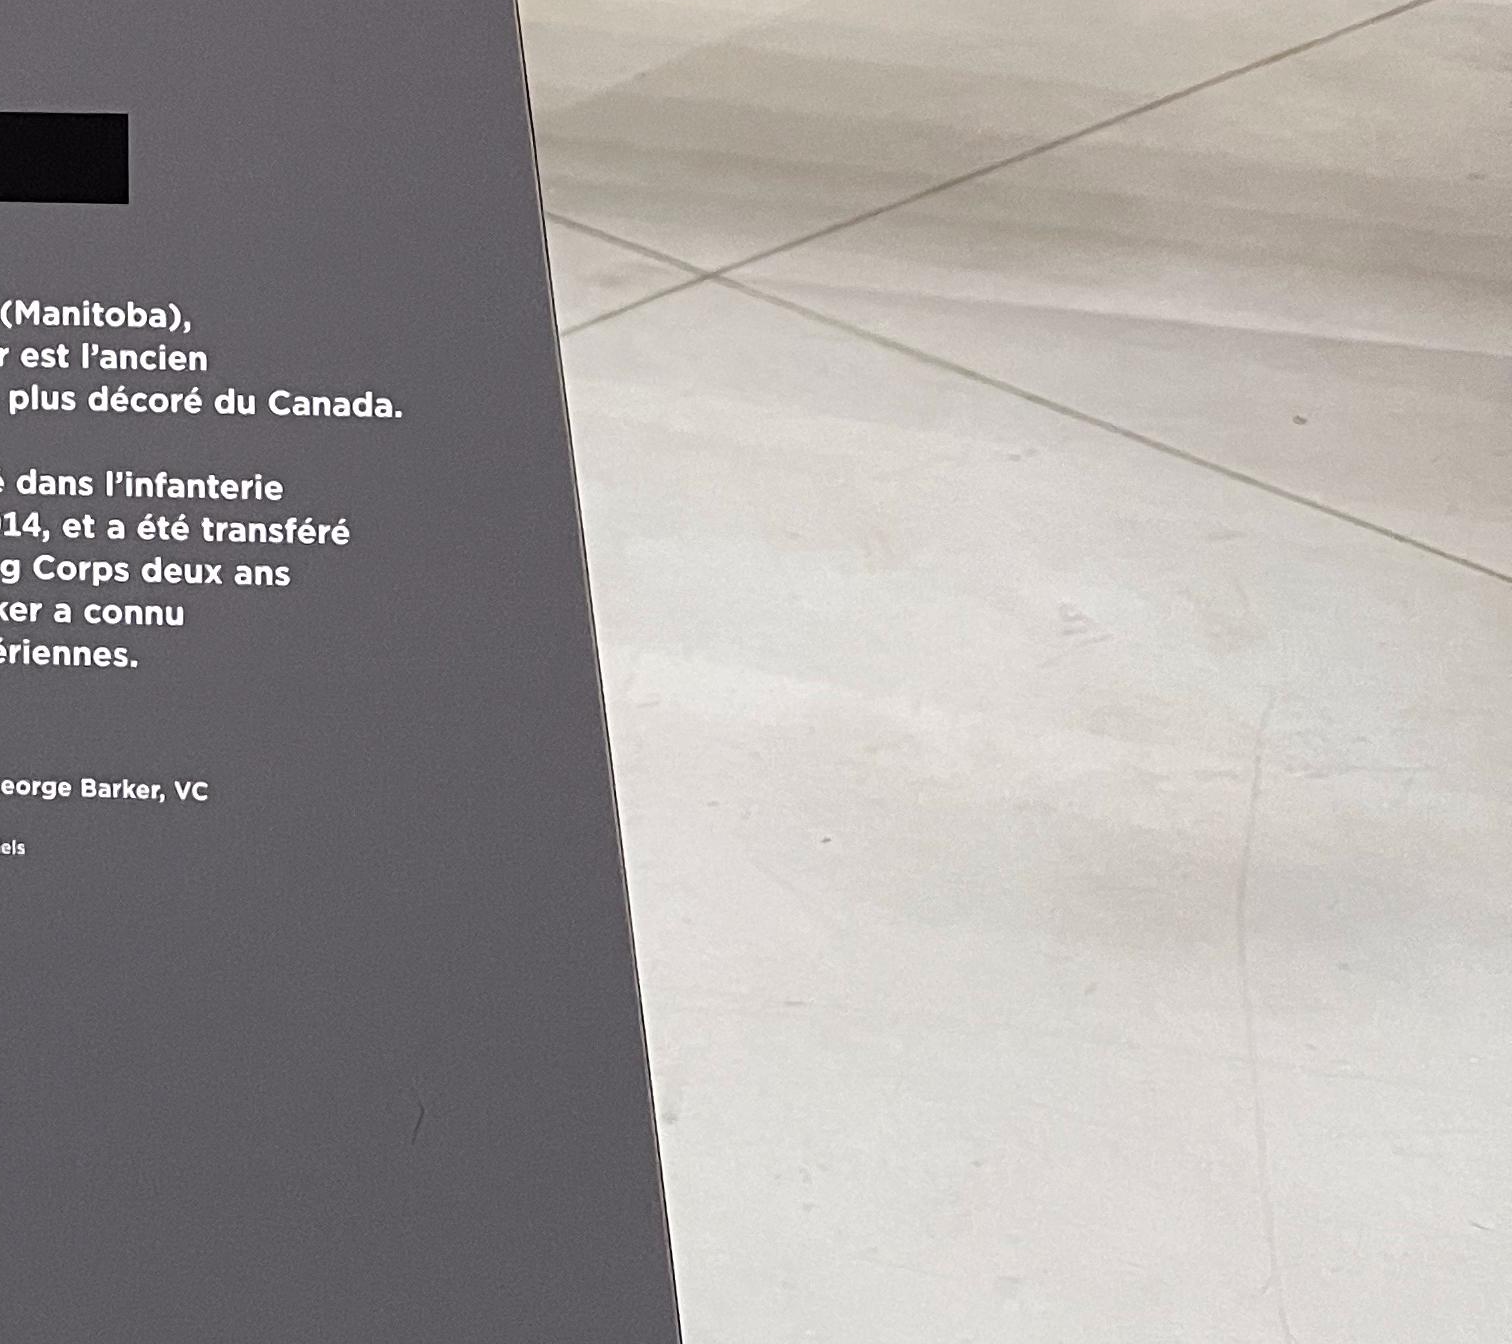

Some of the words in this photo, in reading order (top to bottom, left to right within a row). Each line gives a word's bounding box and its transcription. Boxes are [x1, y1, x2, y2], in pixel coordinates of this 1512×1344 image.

[0, 299, 191, 334] (Manitoba),
[20, 343, 70, 369] est
[9, 383, 76, 415] plus
[87, 385, 203, 414] décoré
[214, 387, 256, 415] du
[268, 389, 403, 418] Canada.
[16, 468, 94, 497] dans
[62, 514, 96, 539] et
[106, 519, 125, 540] a
[137, 513, 190, 542] été
[200, 517, 350, 546] transféré
[32, 554, 130, 587] Corps
[141, 556, 223, 585] deux
[234, 565, 291, 587] ans
[53, 602, 72, 624] a
[83, 603, 184, 626] connu
[80, 777, 166, 804] Barker,
[174, 780, 209, 802] VC
